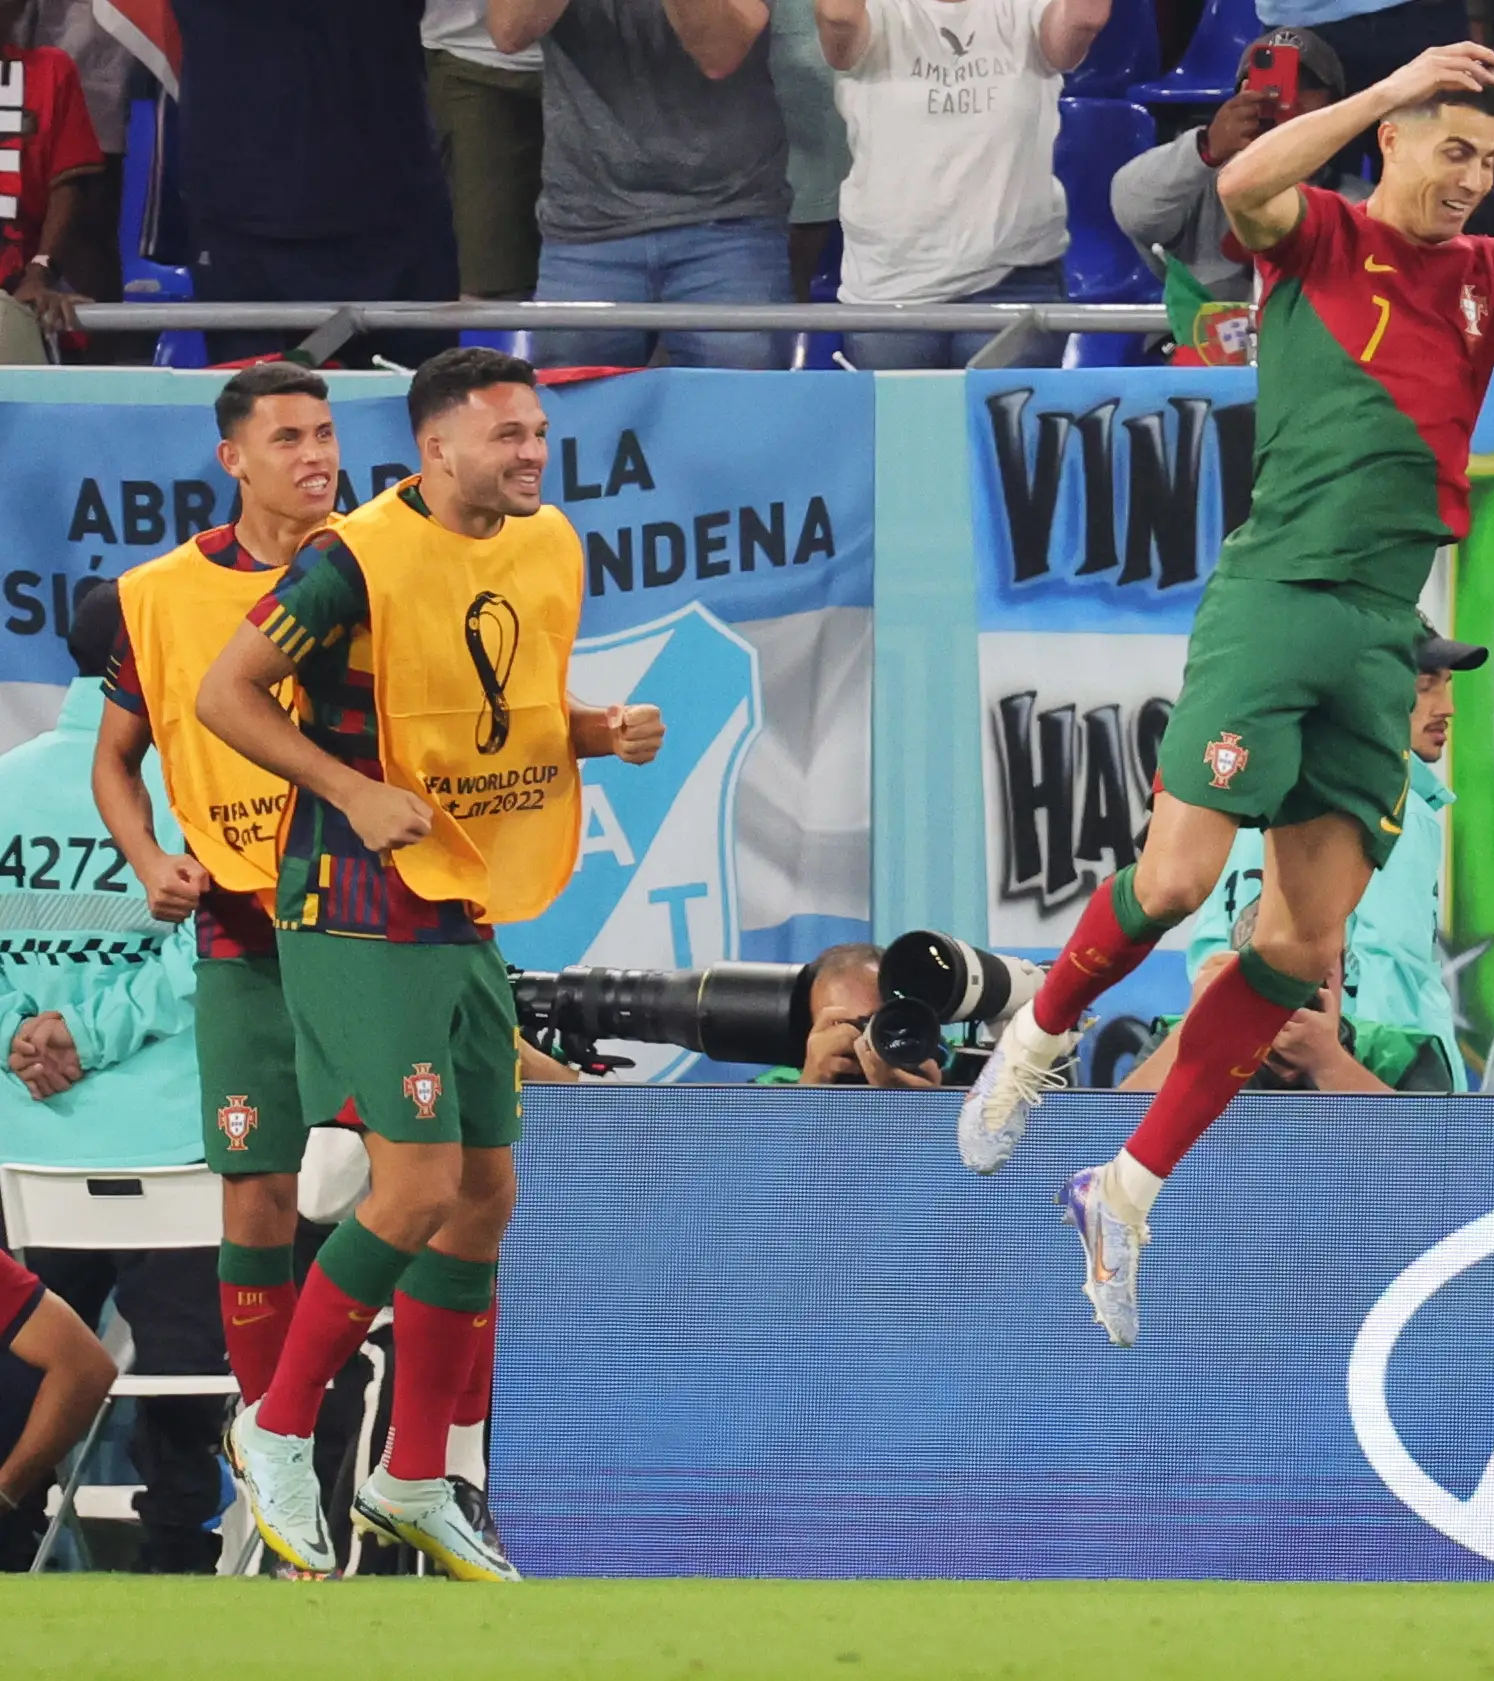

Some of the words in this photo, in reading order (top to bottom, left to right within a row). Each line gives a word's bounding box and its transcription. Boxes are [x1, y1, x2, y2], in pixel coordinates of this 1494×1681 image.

[1360, 295, 1390, 362] 7
[561, 429, 655, 502] LA
[586, 496, 836, 597] NDENA
[209, 801, 250, 822] FIFA
[457, 770, 520, 795] WORLD
[523, 765, 558, 785] CUP
[0, 834, 129, 893] 4272
